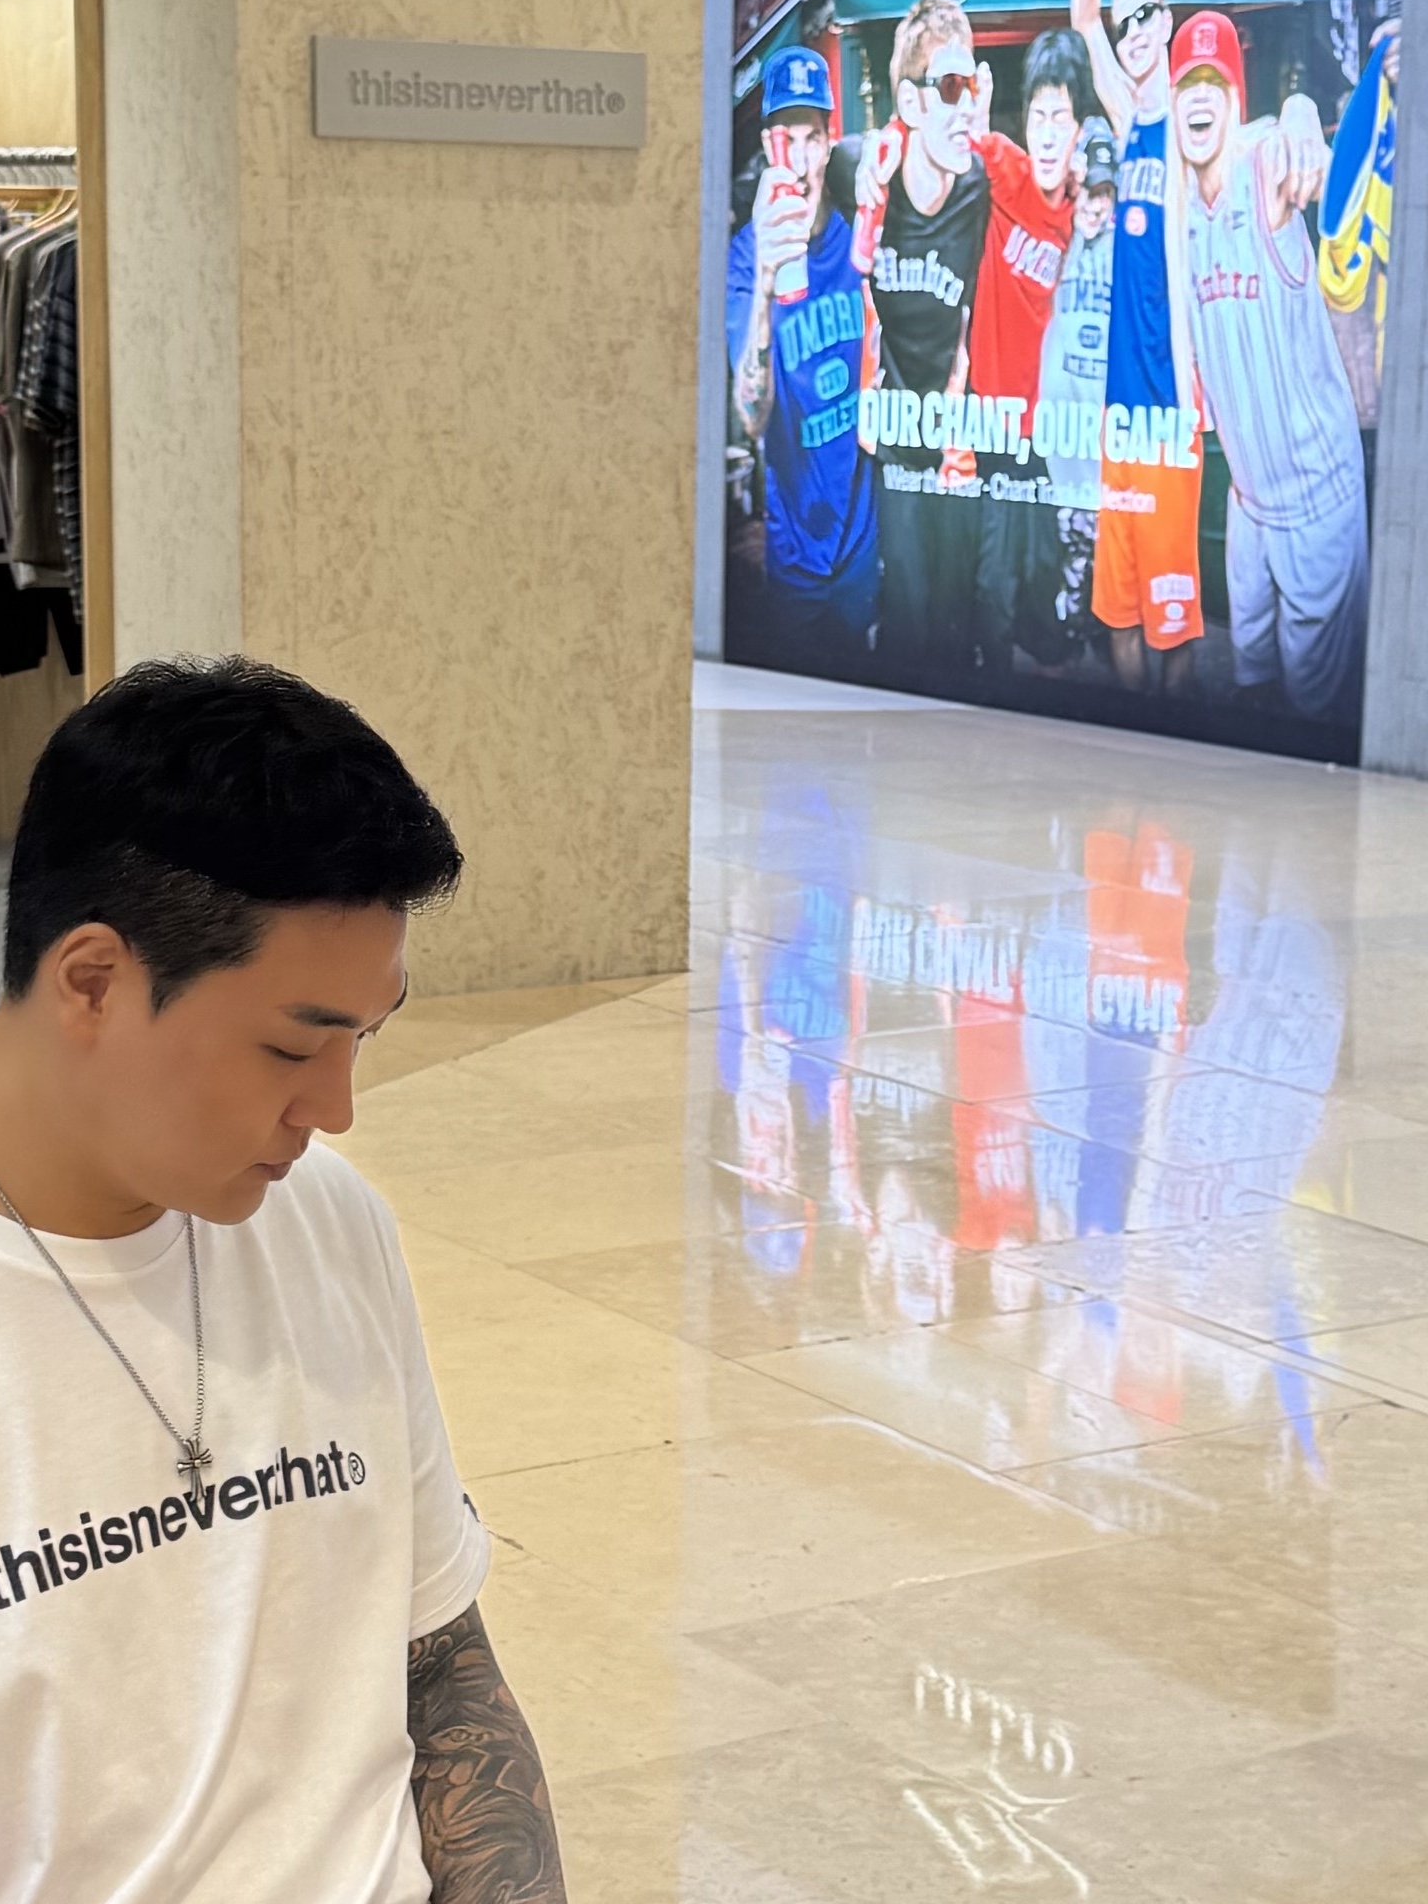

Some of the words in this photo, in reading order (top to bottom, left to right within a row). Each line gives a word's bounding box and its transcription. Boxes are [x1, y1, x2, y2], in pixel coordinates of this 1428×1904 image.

[858, 388, 922, 448] OUR
[922, 390, 1031, 465] CHANT,
[1033, 398, 1102, 461] OUR
[1104, 402, 1201, 469] GAME
